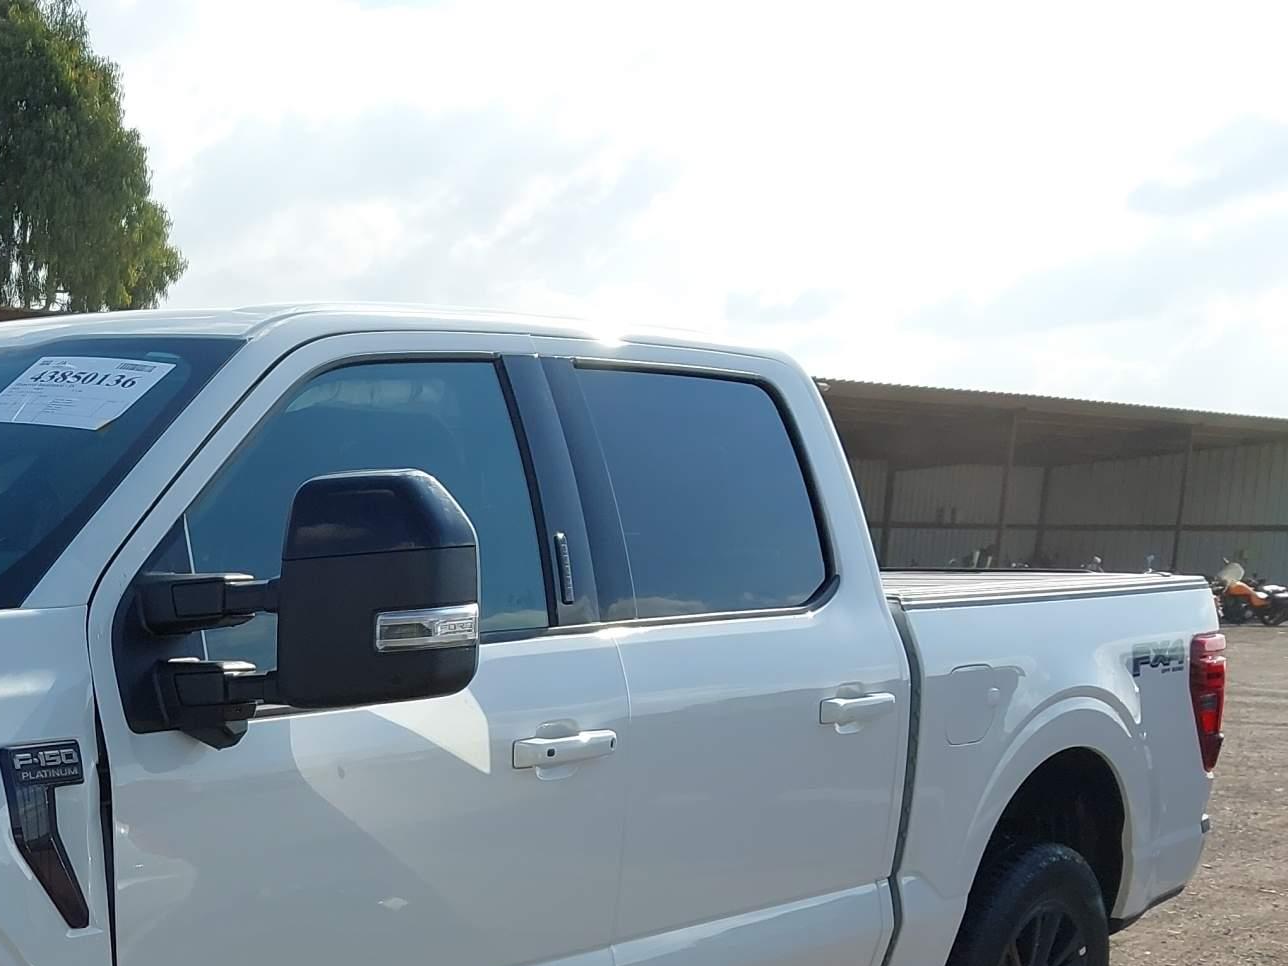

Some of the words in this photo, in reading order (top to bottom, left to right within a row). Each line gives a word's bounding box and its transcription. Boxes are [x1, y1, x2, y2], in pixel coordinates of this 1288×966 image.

[30, 370, 138, 388] 43850136
[1132, 640, 1184, 677] FX4
[13, 748, 79, 770] F-150
[21, 766, 79, 780] PLATINUM
